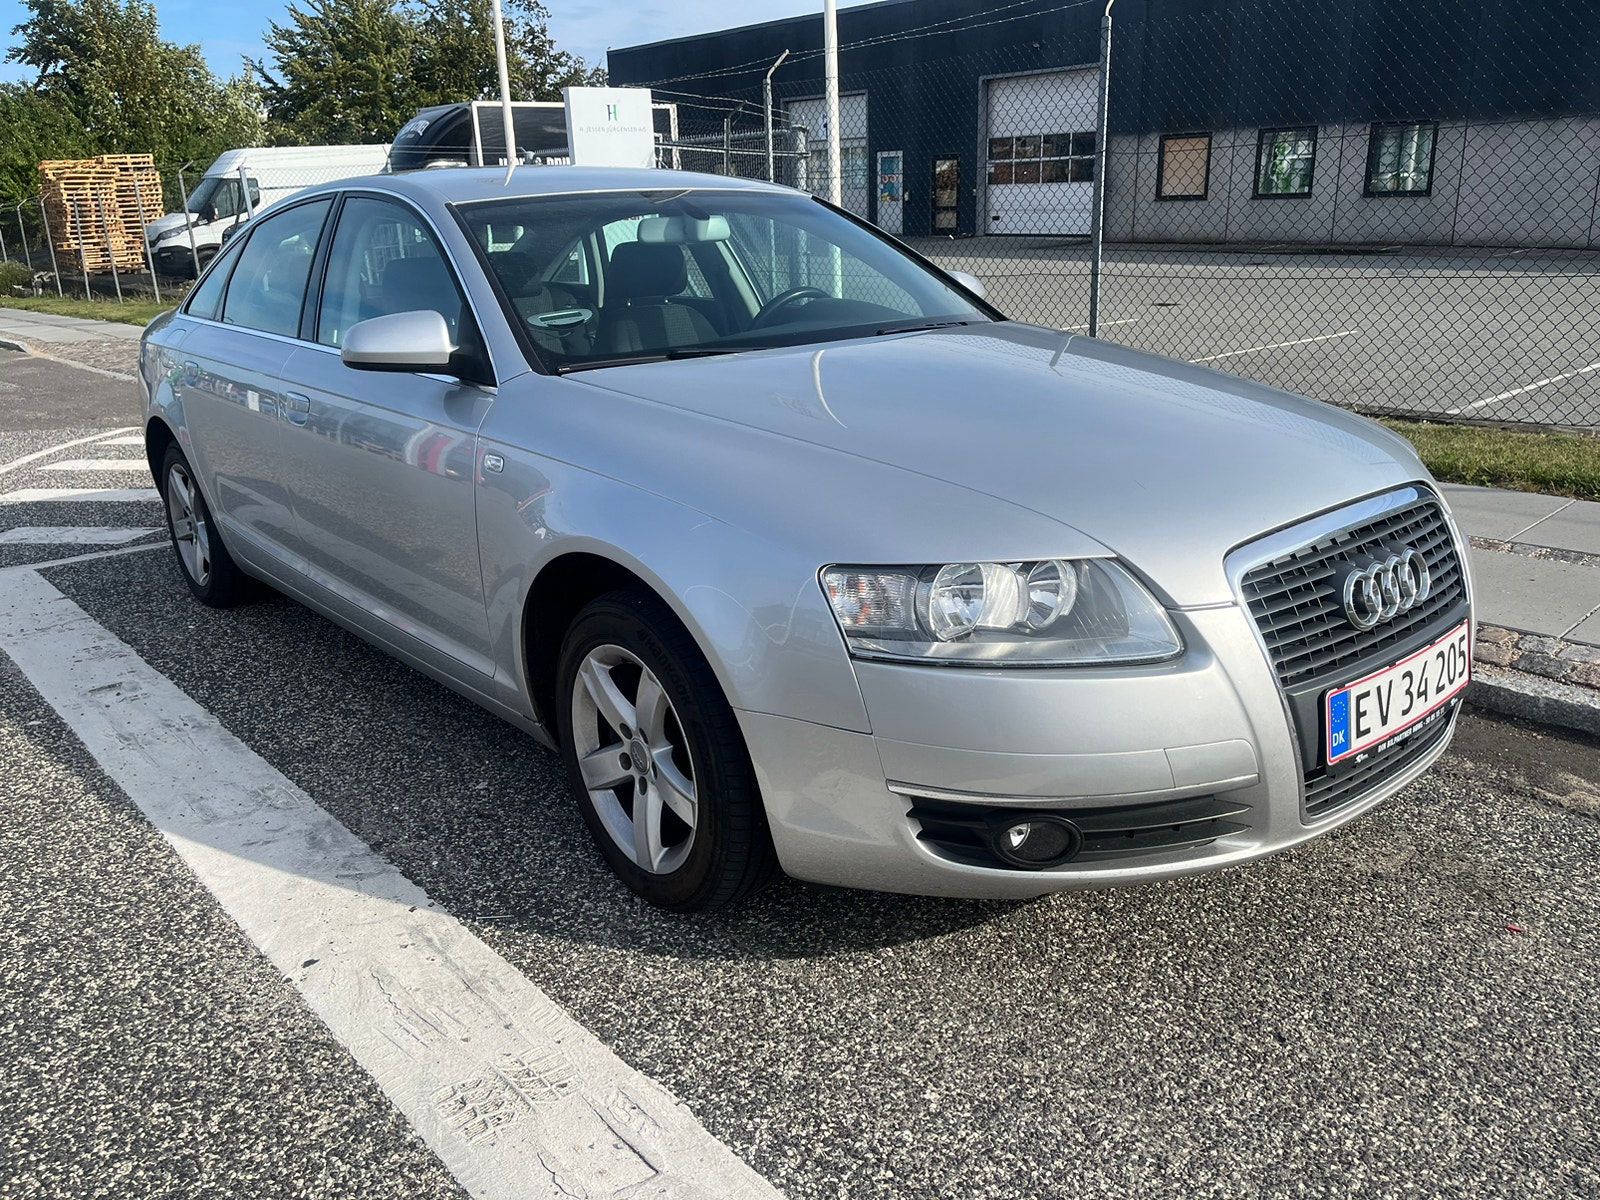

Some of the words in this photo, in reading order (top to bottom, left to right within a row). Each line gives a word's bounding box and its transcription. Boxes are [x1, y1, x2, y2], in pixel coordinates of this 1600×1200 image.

[1356, 679, 1393, 740] EV
[1402, 660, 1428, 716] 34
[1435, 634, 1466, 695] 205
[1332, 729, 1345, 747] DK
